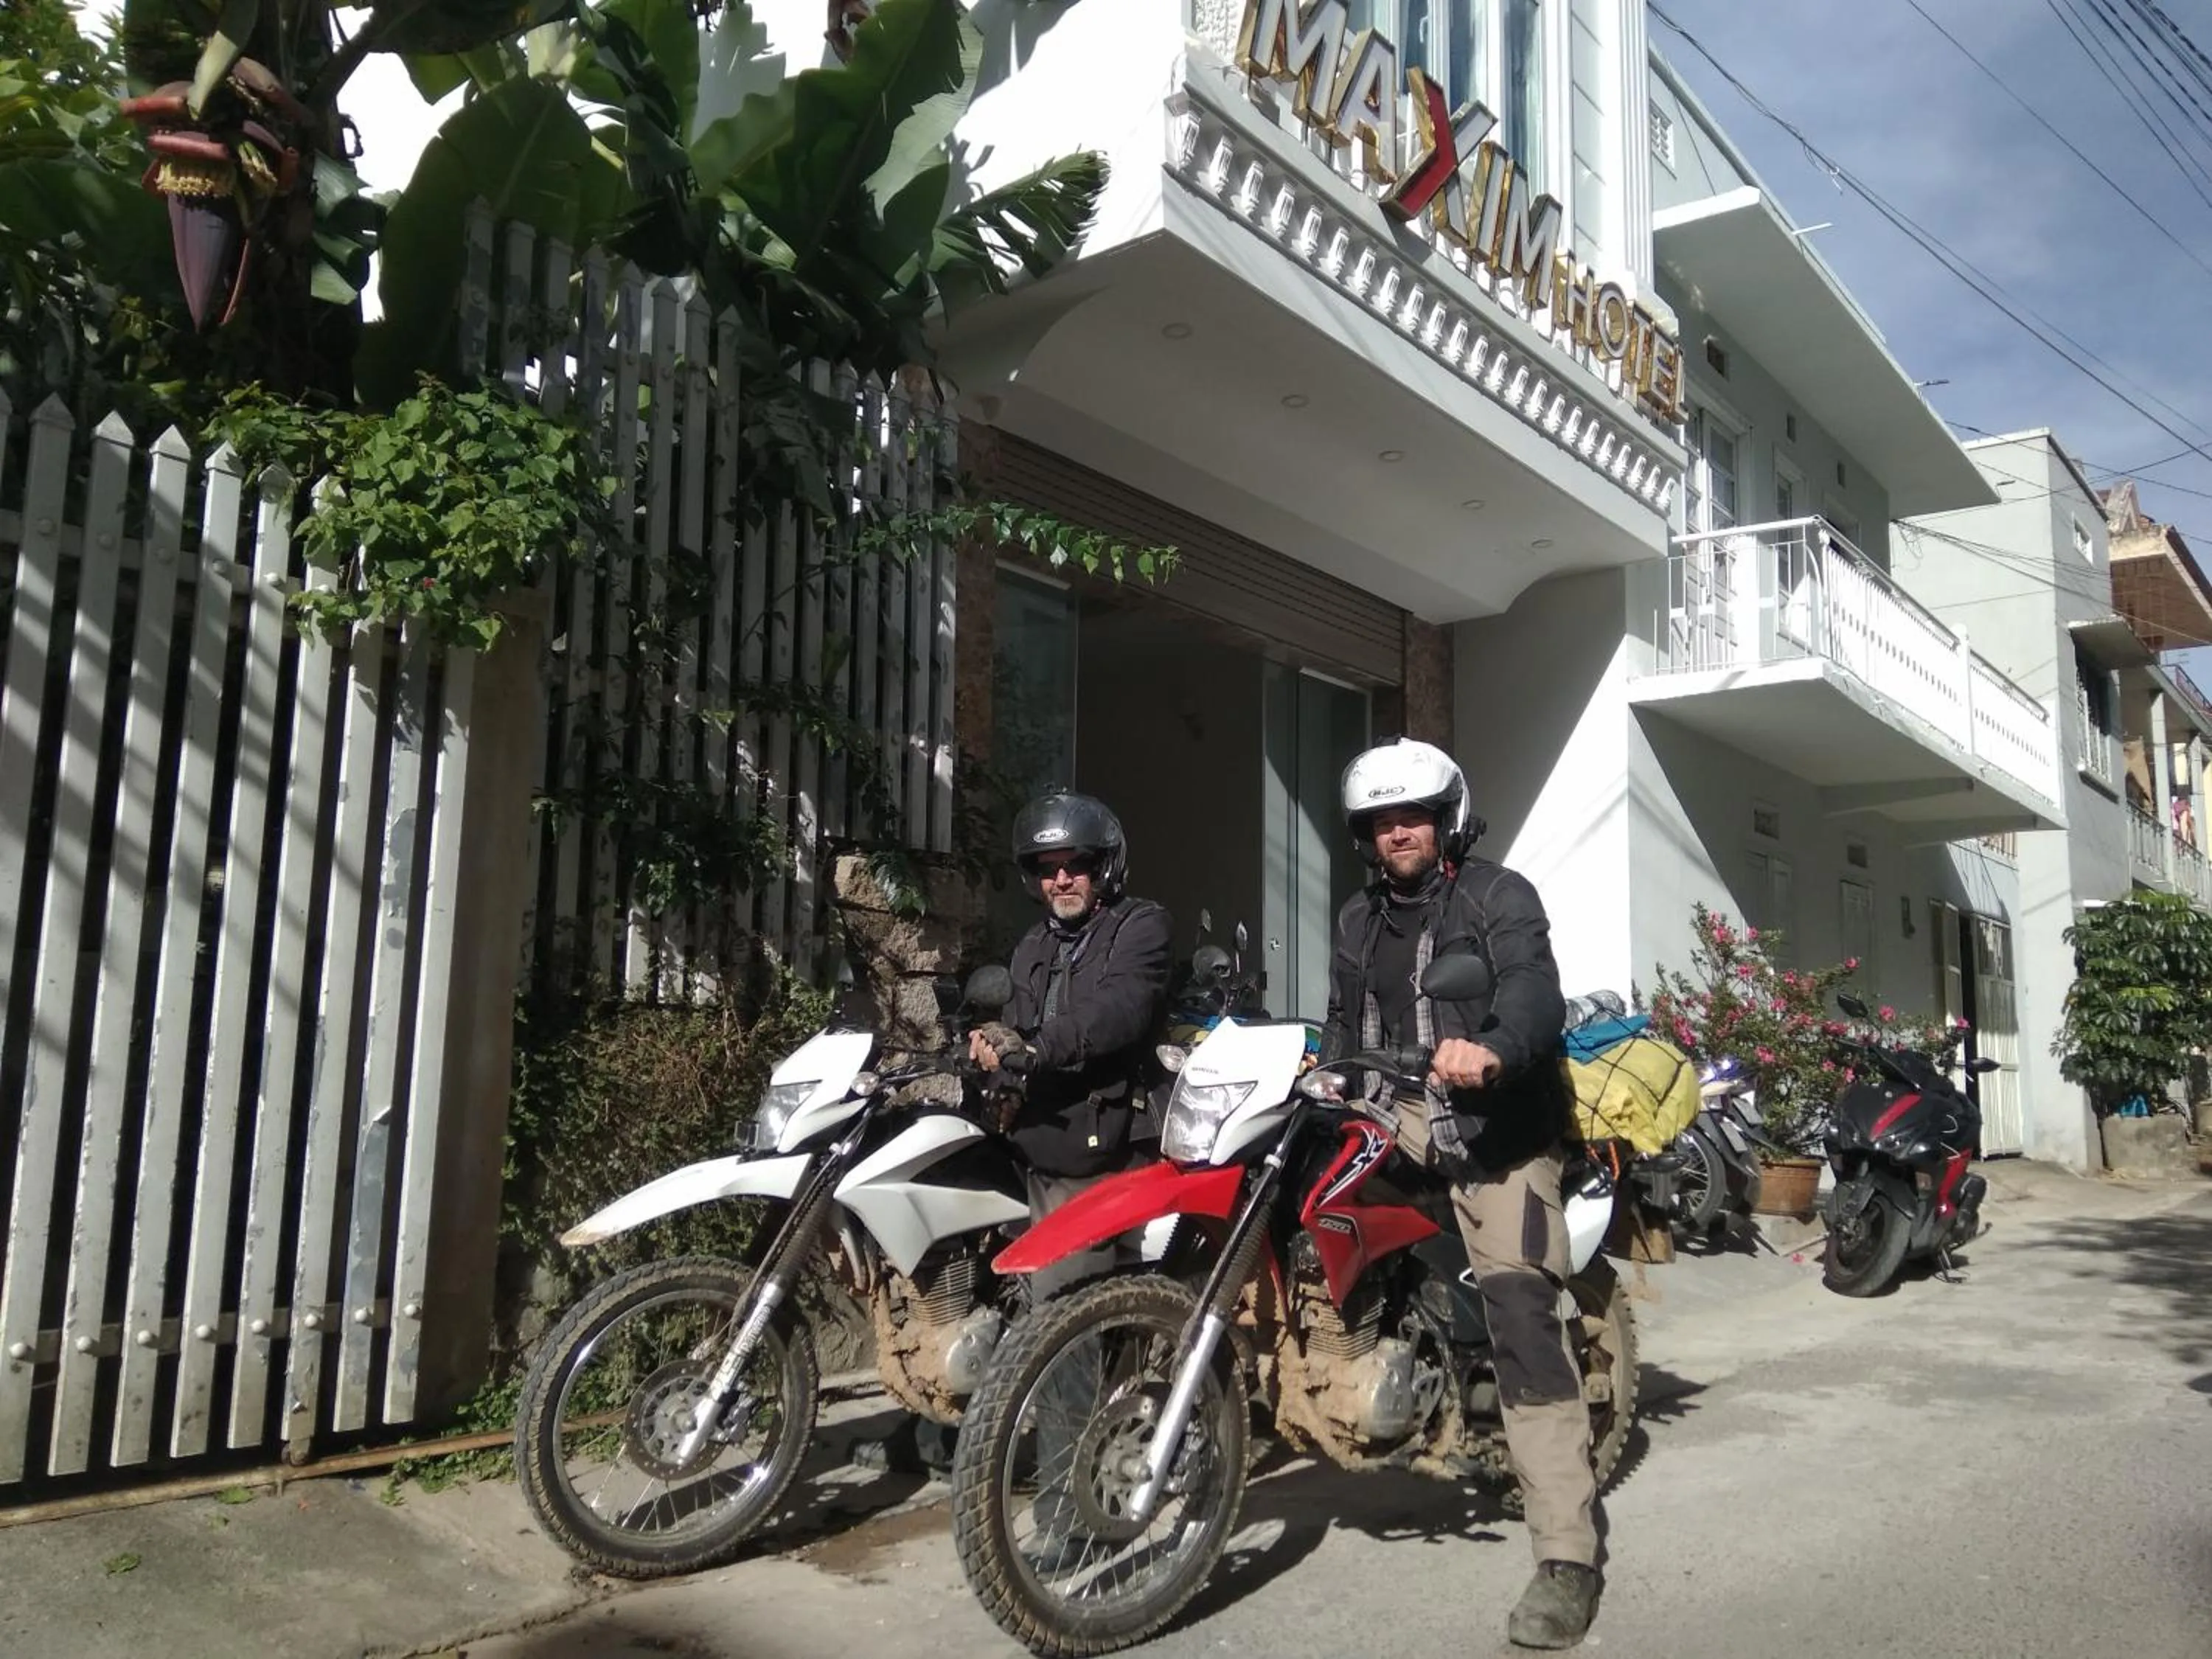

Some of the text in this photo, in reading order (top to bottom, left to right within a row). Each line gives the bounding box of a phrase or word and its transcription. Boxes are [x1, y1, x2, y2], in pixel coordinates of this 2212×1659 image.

[1234, 0, 1688, 424] MAXIM HOTEL
[1371, 786, 1402, 796] HJC
